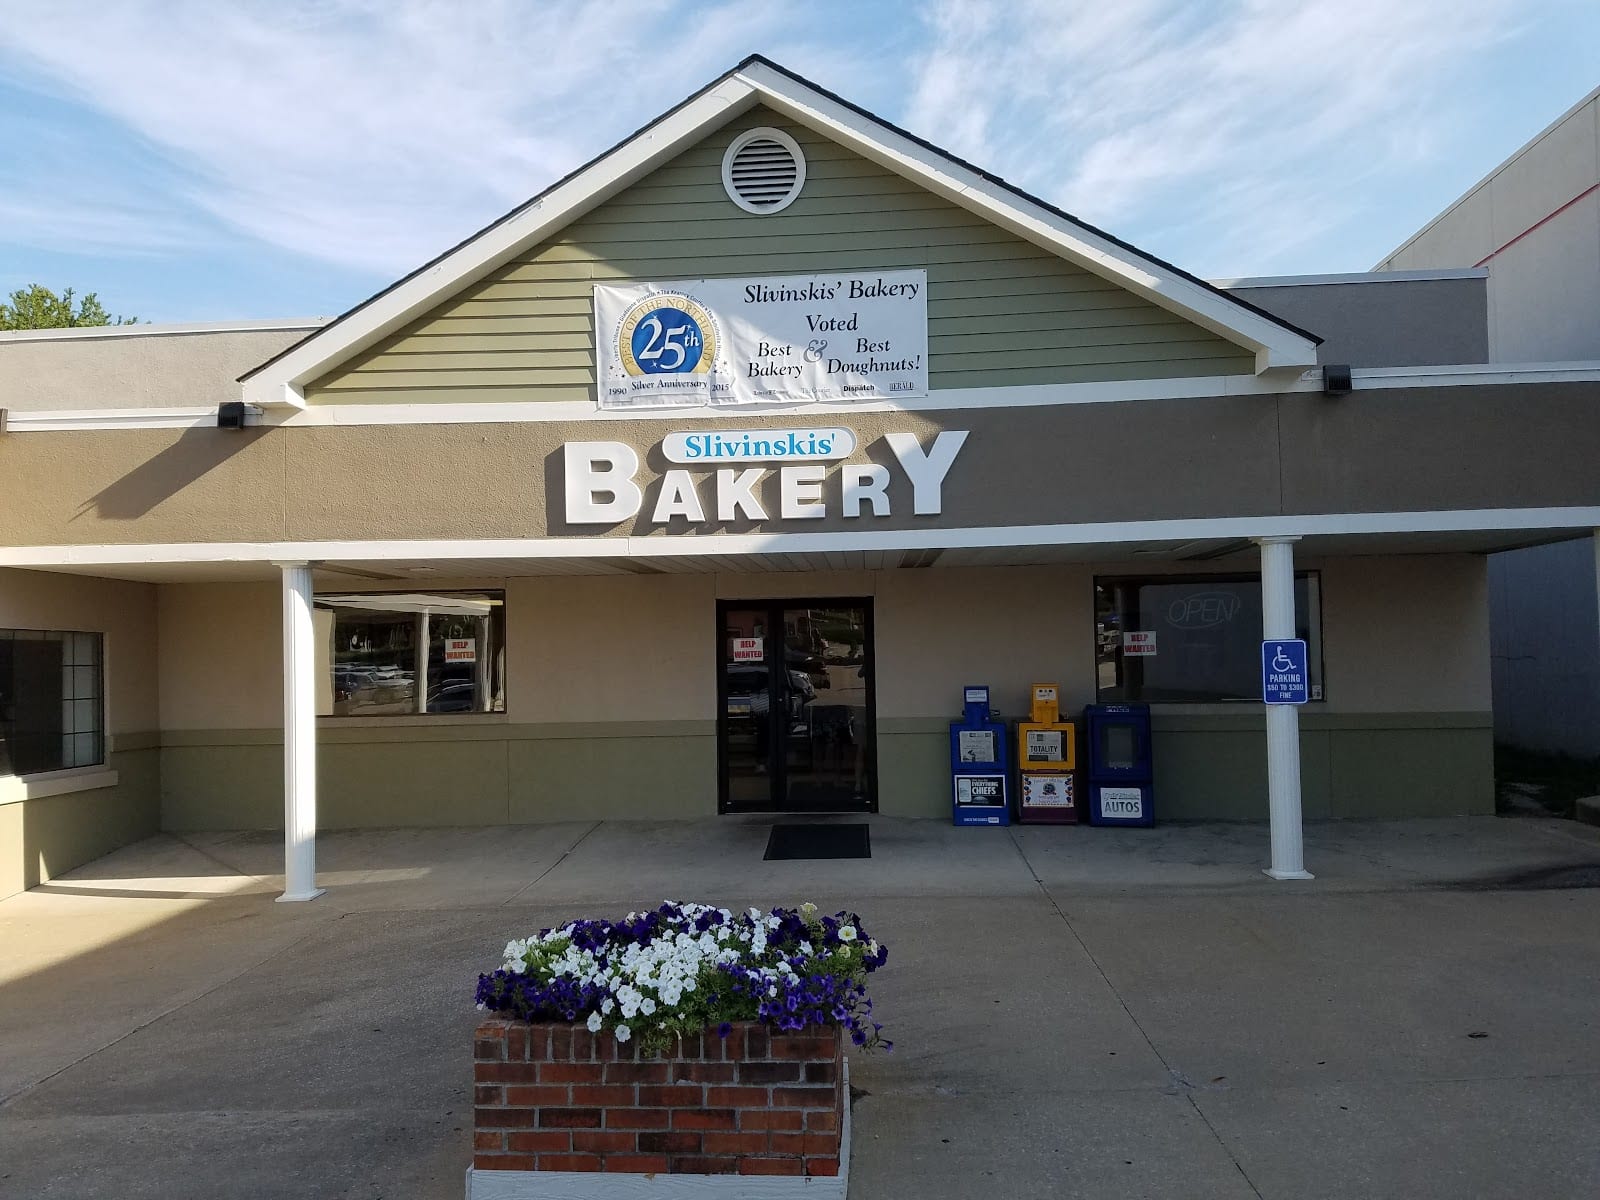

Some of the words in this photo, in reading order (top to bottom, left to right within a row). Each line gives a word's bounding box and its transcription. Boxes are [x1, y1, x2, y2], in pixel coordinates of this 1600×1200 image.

[848, 279, 920, 302] Bakery
[636, 299, 663, 314] THE
[625, 315, 639, 331] OF
[805, 312, 859, 333] Voted
[666, 298, 714, 361] NORTHLAND
[621, 333, 635, 366] BEST
[638, 317, 700, 370] 25th
[758, 341, 792, 358] Best
[802, 338, 828, 363] &
[855, 336, 892, 354] Best
[747, 360, 803, 379] Bakery
[826, 354, 921, 376] Doughnuts!
[631, 381, 655, 391] Silver
[656, 379, 708, 391] Anniversary
[711, 383, 730, 392] 2015
[843, 384, 875, 392] Dispatch
[608, 387, 627, 396] 1990
[1168, 598, 1236, 623] OPEN
[740, 640, 756, 648] HELP
[1131, 634, 1149, 642] HELP
[734, 650, 763, 659] WANTED
[1124, 644, 1155, 653] WANTED
[446, 651, 475, 659] WANTED
[1269, 673, 1301, 683] PARKING
[1279, 691, 1293, 699] FINE
[971, 786, 997, 795] CHIEFS
[1104, 801, 1140, 813] AUTOS
